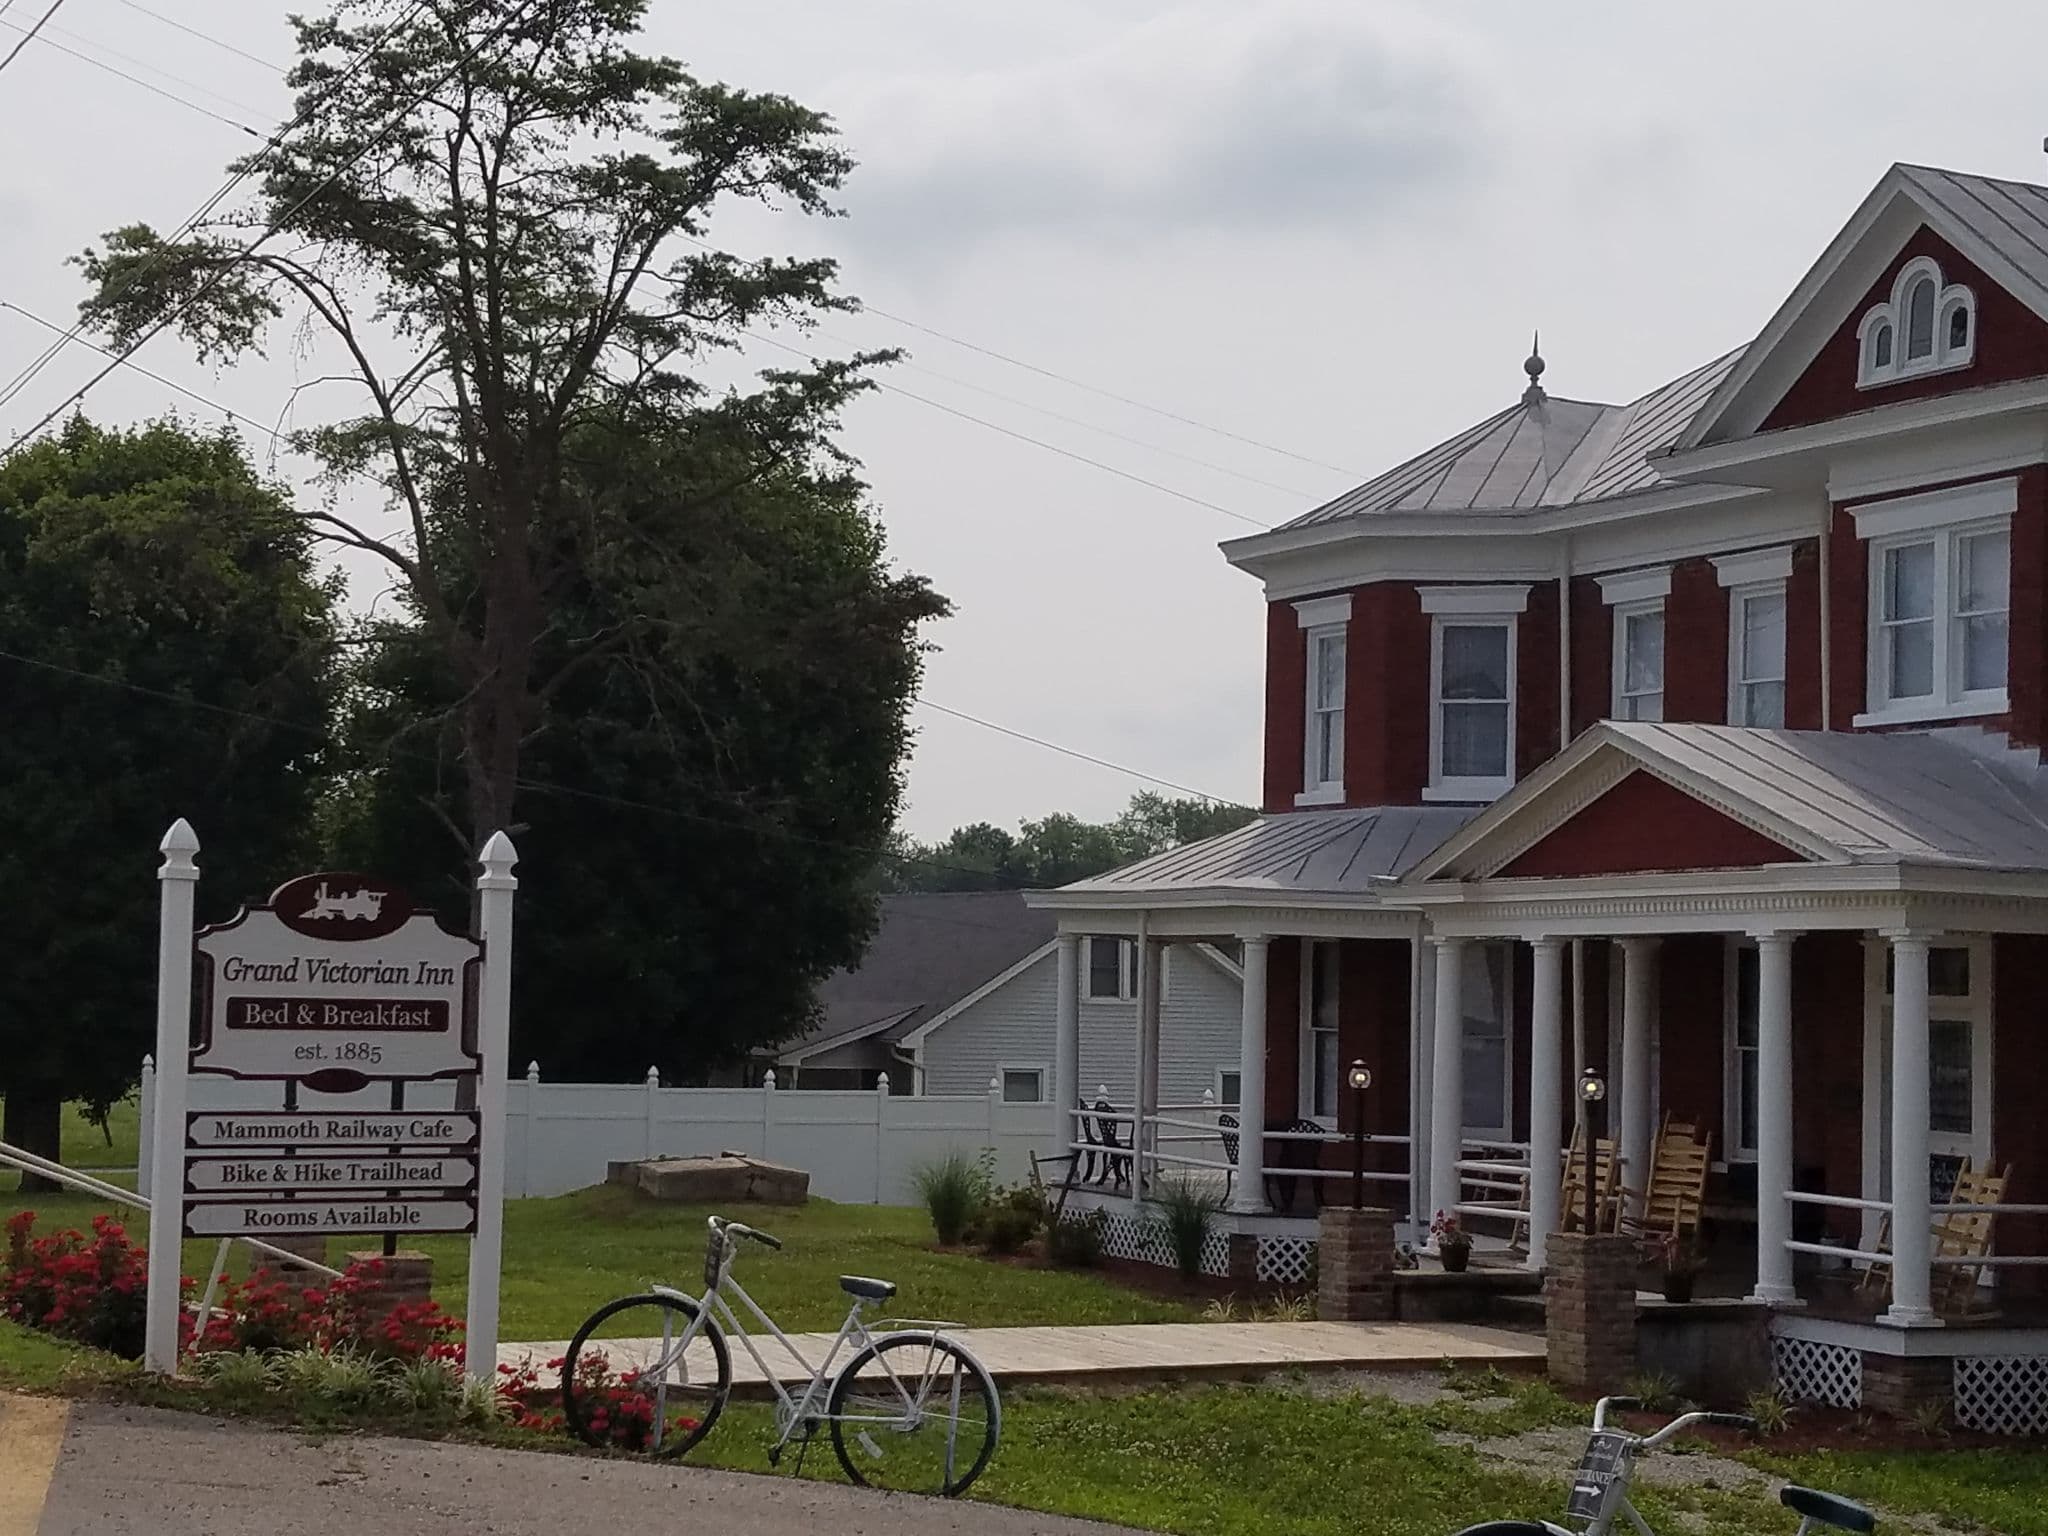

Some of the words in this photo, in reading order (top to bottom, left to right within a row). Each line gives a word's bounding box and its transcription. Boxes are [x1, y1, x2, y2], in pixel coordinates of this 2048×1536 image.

[223, 956, 299, 983] Grand
[305, 958, 410, 985] Victorian
[415, 961, 455, 986] Inn
[245, 1002, 289, 1025] Bed
[297, 1003, 316, 1025] &
[323, 1003, 431, 1026] Breakfast
[294, 1043, 328, 1060] est.
[335, 1042, 382, 1064] 1885
[214, 1119, 320, 1138] Mammoth
[326, 1119, 405, 1142] Railway
[409, 1119, 453, 1138] Cafe
[221, 1163, 268, 1183] Bike
[272, 1163, 289, 1182] &
[294, 1162, 342, 1182] Hike
[346, 1161, 443, 1181] Trailhead
[243, 1208, 318, 1227] Rooms
[322, 1205, 421, 1225] Available
